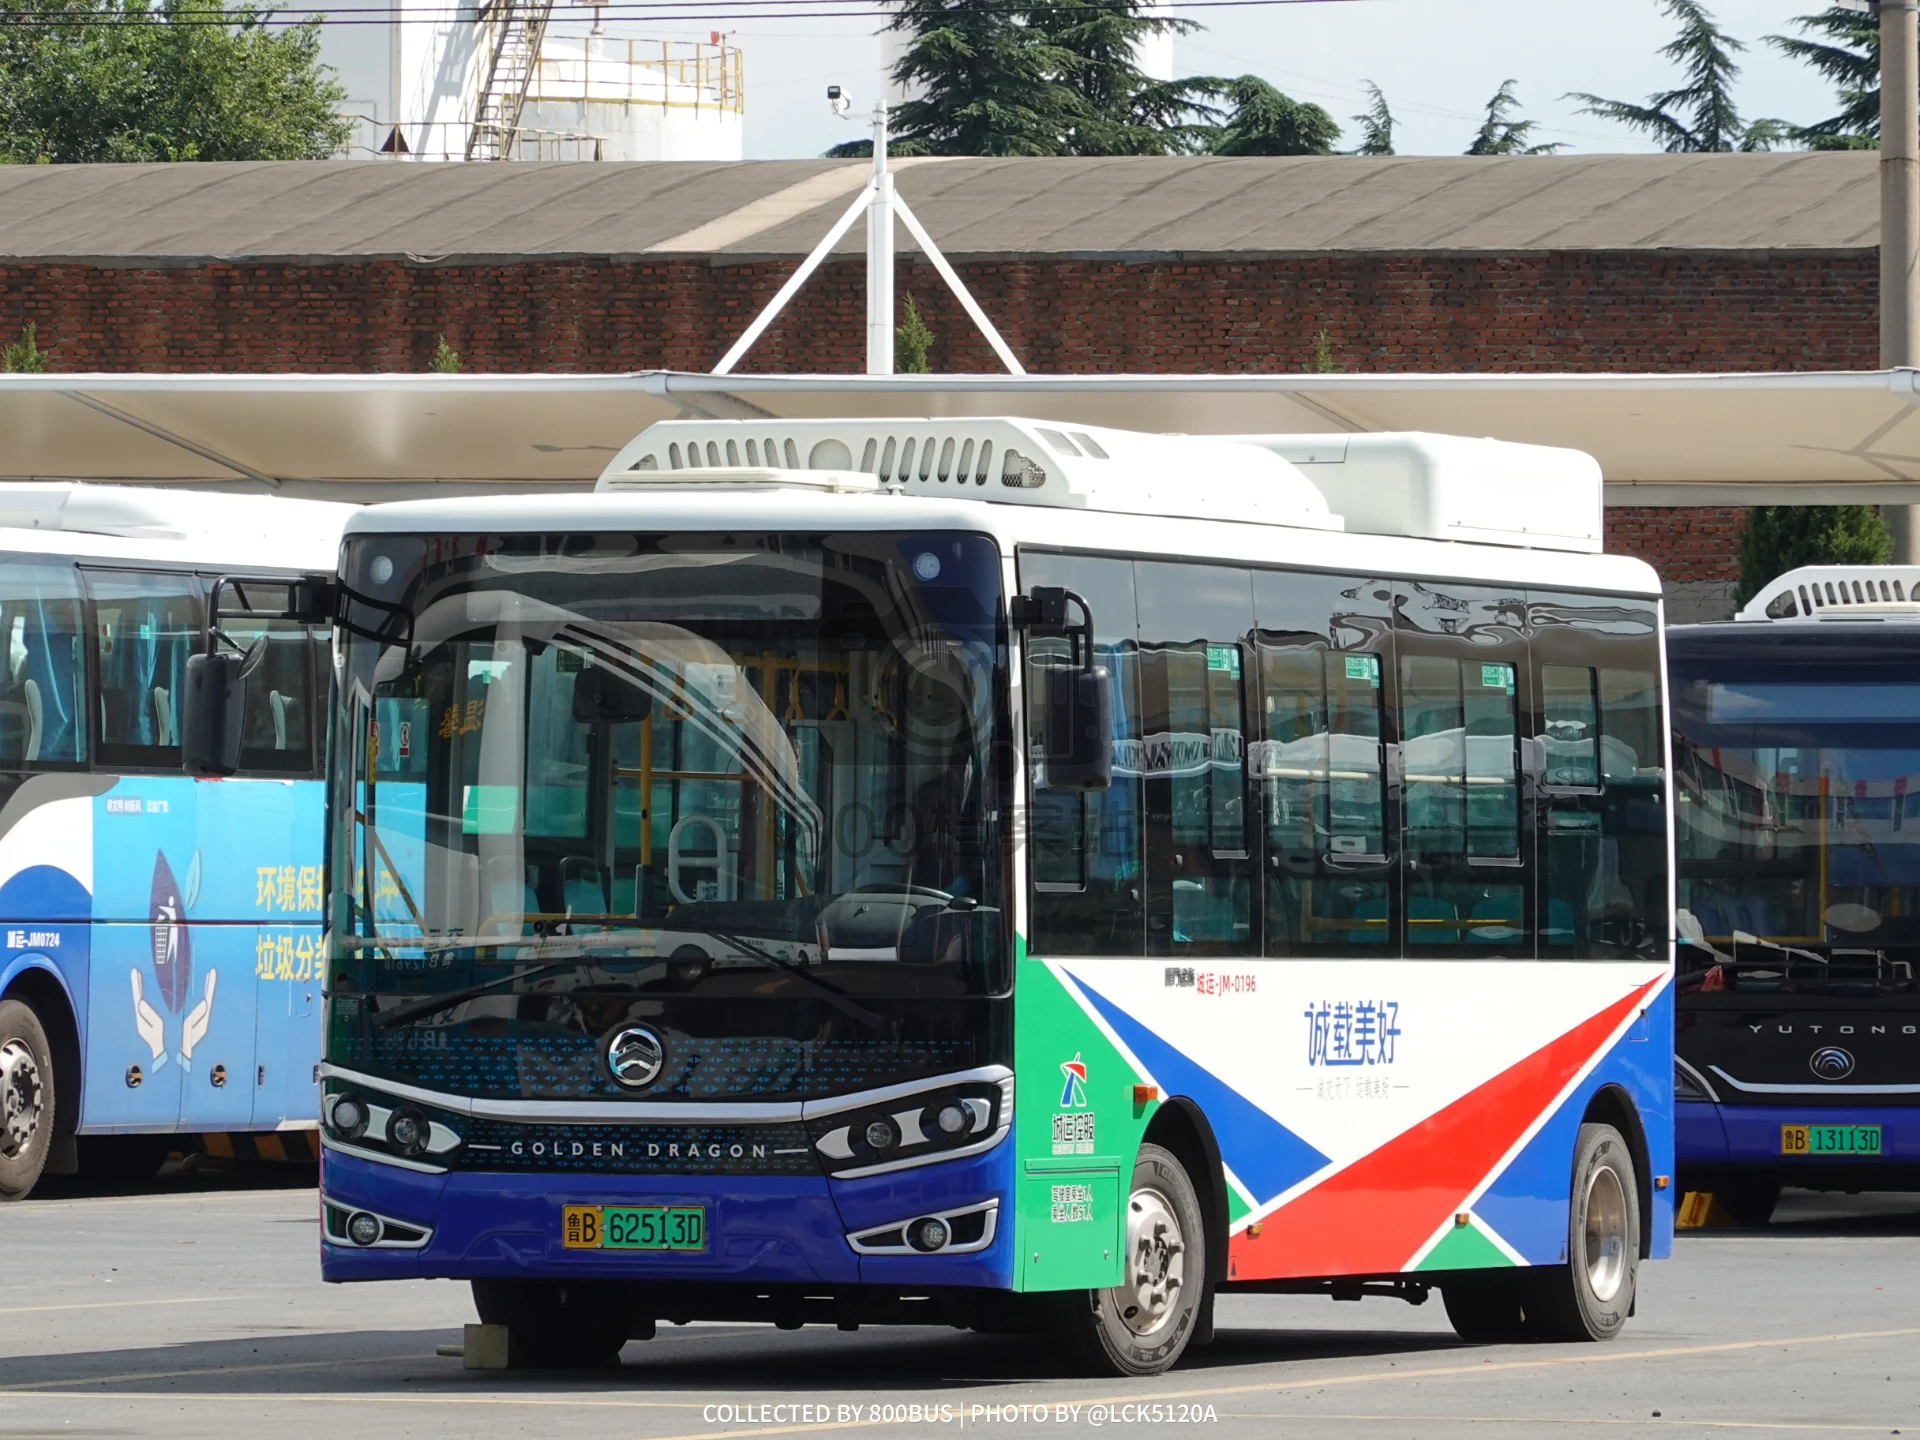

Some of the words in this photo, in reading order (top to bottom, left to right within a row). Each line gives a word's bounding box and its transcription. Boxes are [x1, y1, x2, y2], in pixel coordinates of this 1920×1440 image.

[1304, 999, 1401, 1067] 诚载美好
[1749, 1025, 1917, 1034] YUTONG
[1052, 1113, 1094, 1143] 城运控股
[511, 1142, 624, 1157] GOLDEN
[648, 1143, 766, 1158] DRAGON
